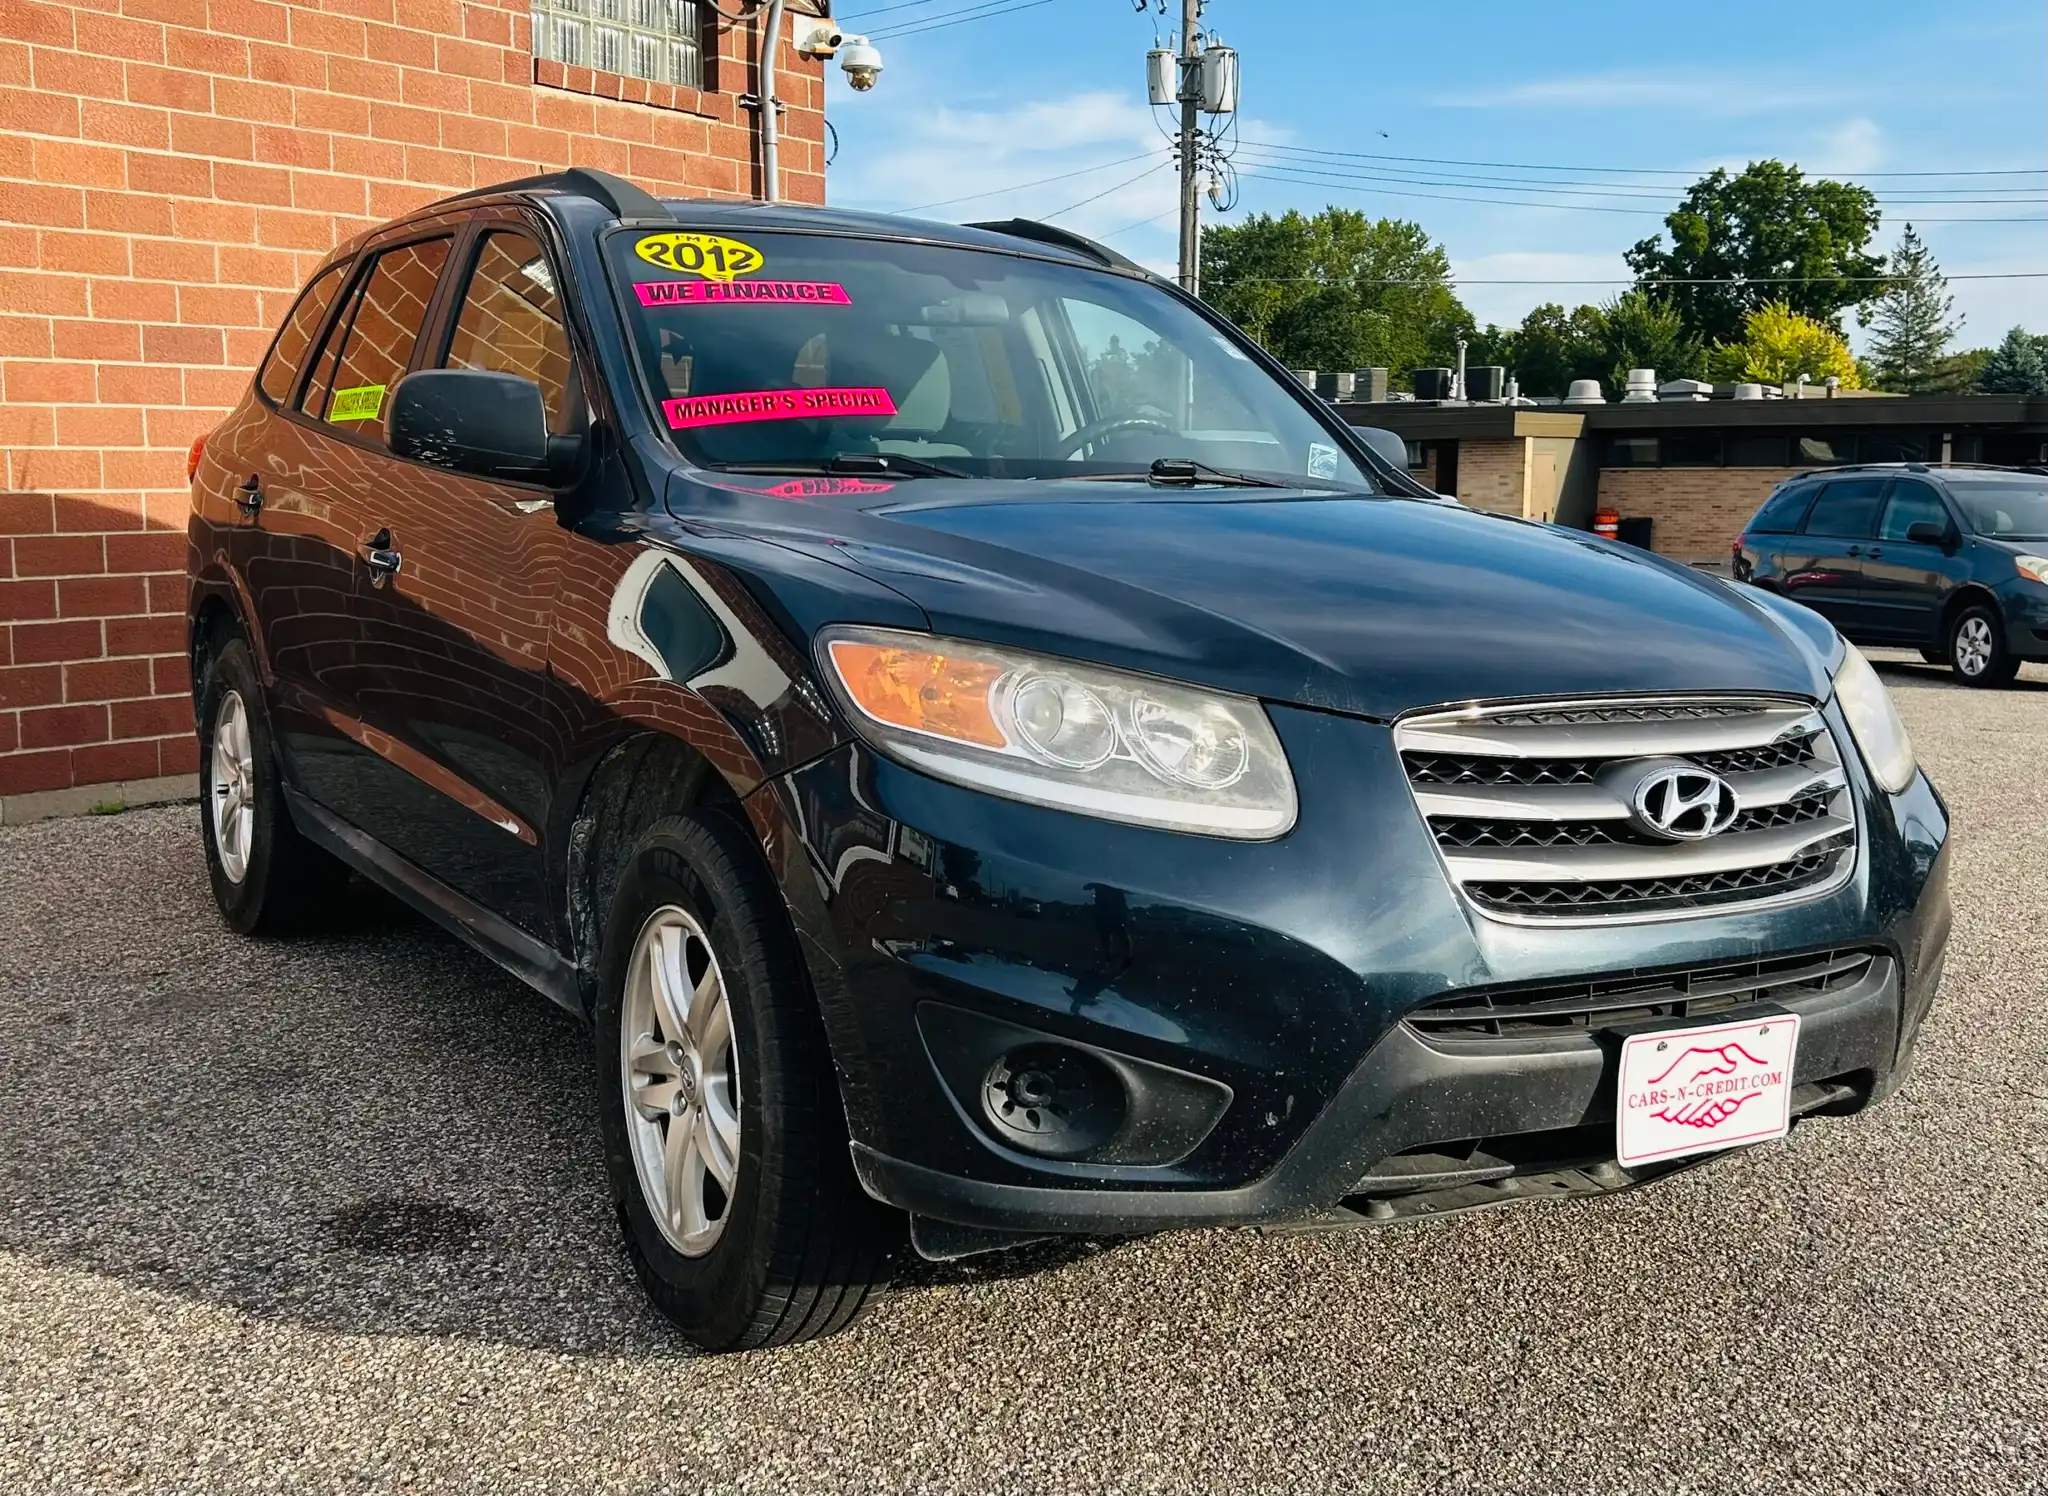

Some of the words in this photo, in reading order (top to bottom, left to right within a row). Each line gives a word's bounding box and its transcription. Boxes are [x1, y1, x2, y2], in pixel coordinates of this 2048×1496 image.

[675, 234, 701, 243] I'M
[643, 241, 755, 273] 2012
[646, 283, 693, 301] WE
[705, 283, 833, 300] FINANCE
[675, 394, 796, 420] MANAGER'S
[803, 393, 881, 409] SPECIAL
[1627, 1071, 1784, 1110] CARS-N-CREDIT.COM
